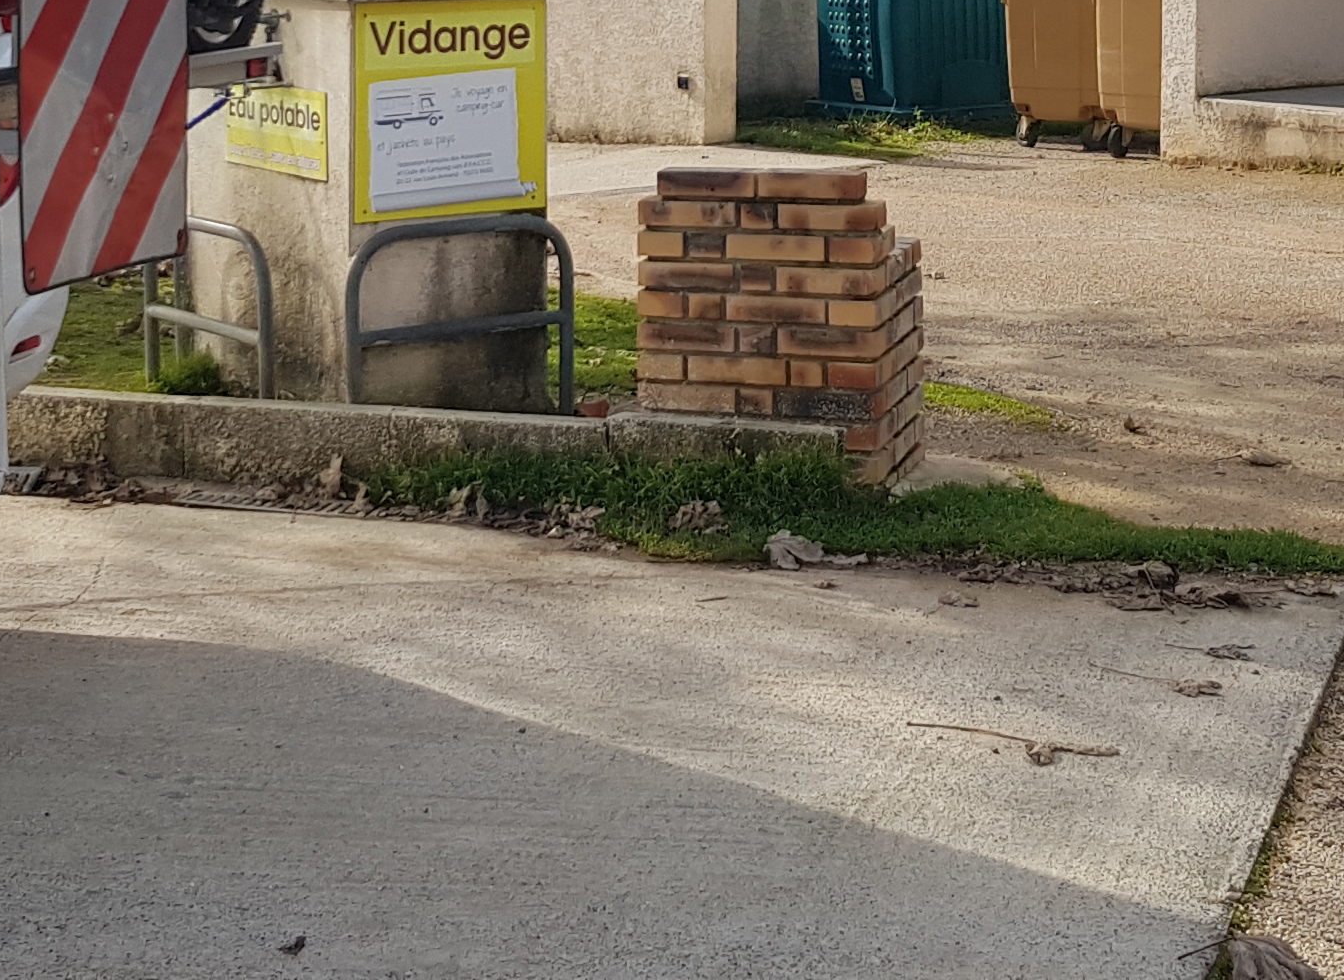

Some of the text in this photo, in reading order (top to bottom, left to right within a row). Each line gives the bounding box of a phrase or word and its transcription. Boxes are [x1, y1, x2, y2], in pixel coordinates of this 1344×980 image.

[369, 19, 531, 60] Vidange
[229, 99, 321, 131] Eau potable
